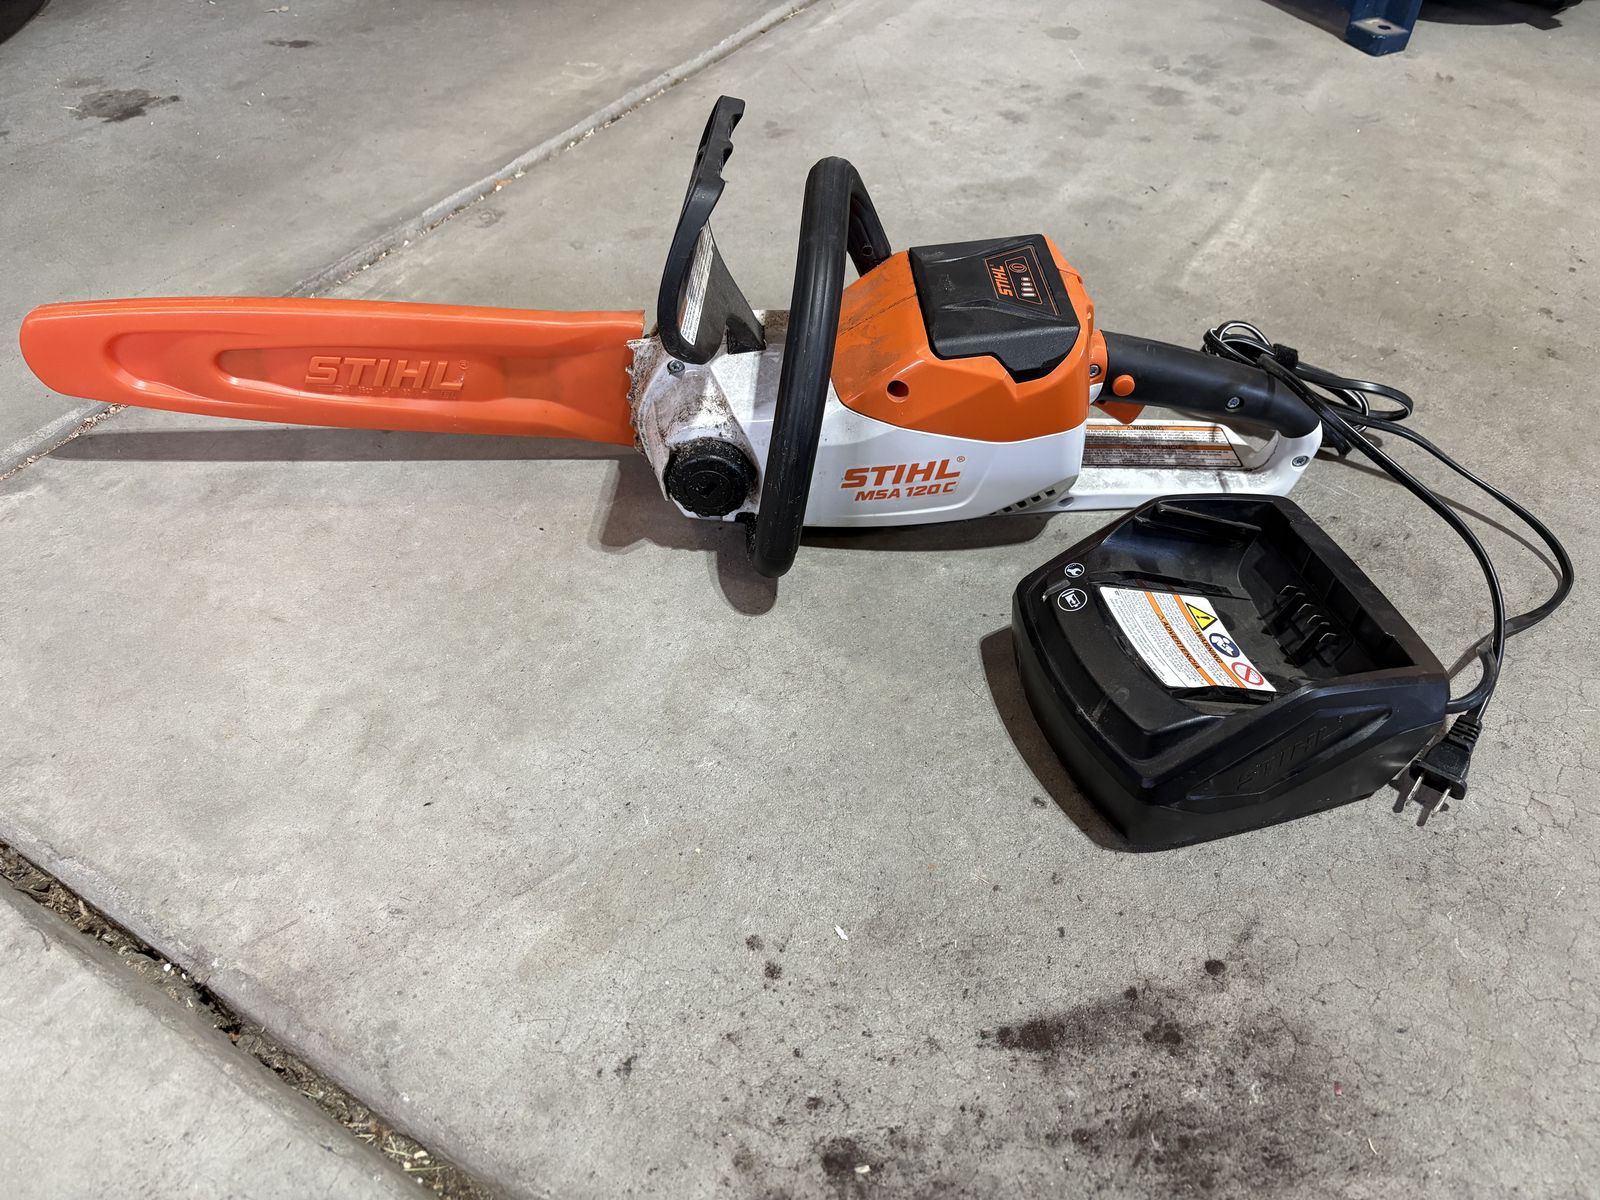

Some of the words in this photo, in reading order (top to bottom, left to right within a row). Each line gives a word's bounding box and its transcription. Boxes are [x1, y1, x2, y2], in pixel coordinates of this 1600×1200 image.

[991, 265, 1013, 297] STIHL
[304, 355, 465, 391] STIHL
[840, 459, 961, 489] STIHL
[854, 488, 900, 502] MSA
[905, 483, 942, 498] 120
[942, 481, 957, 493] C
[1161, 618, 1201, 670] ADVERTENCIA
[1195, 629, 1224, 664] WARNING
